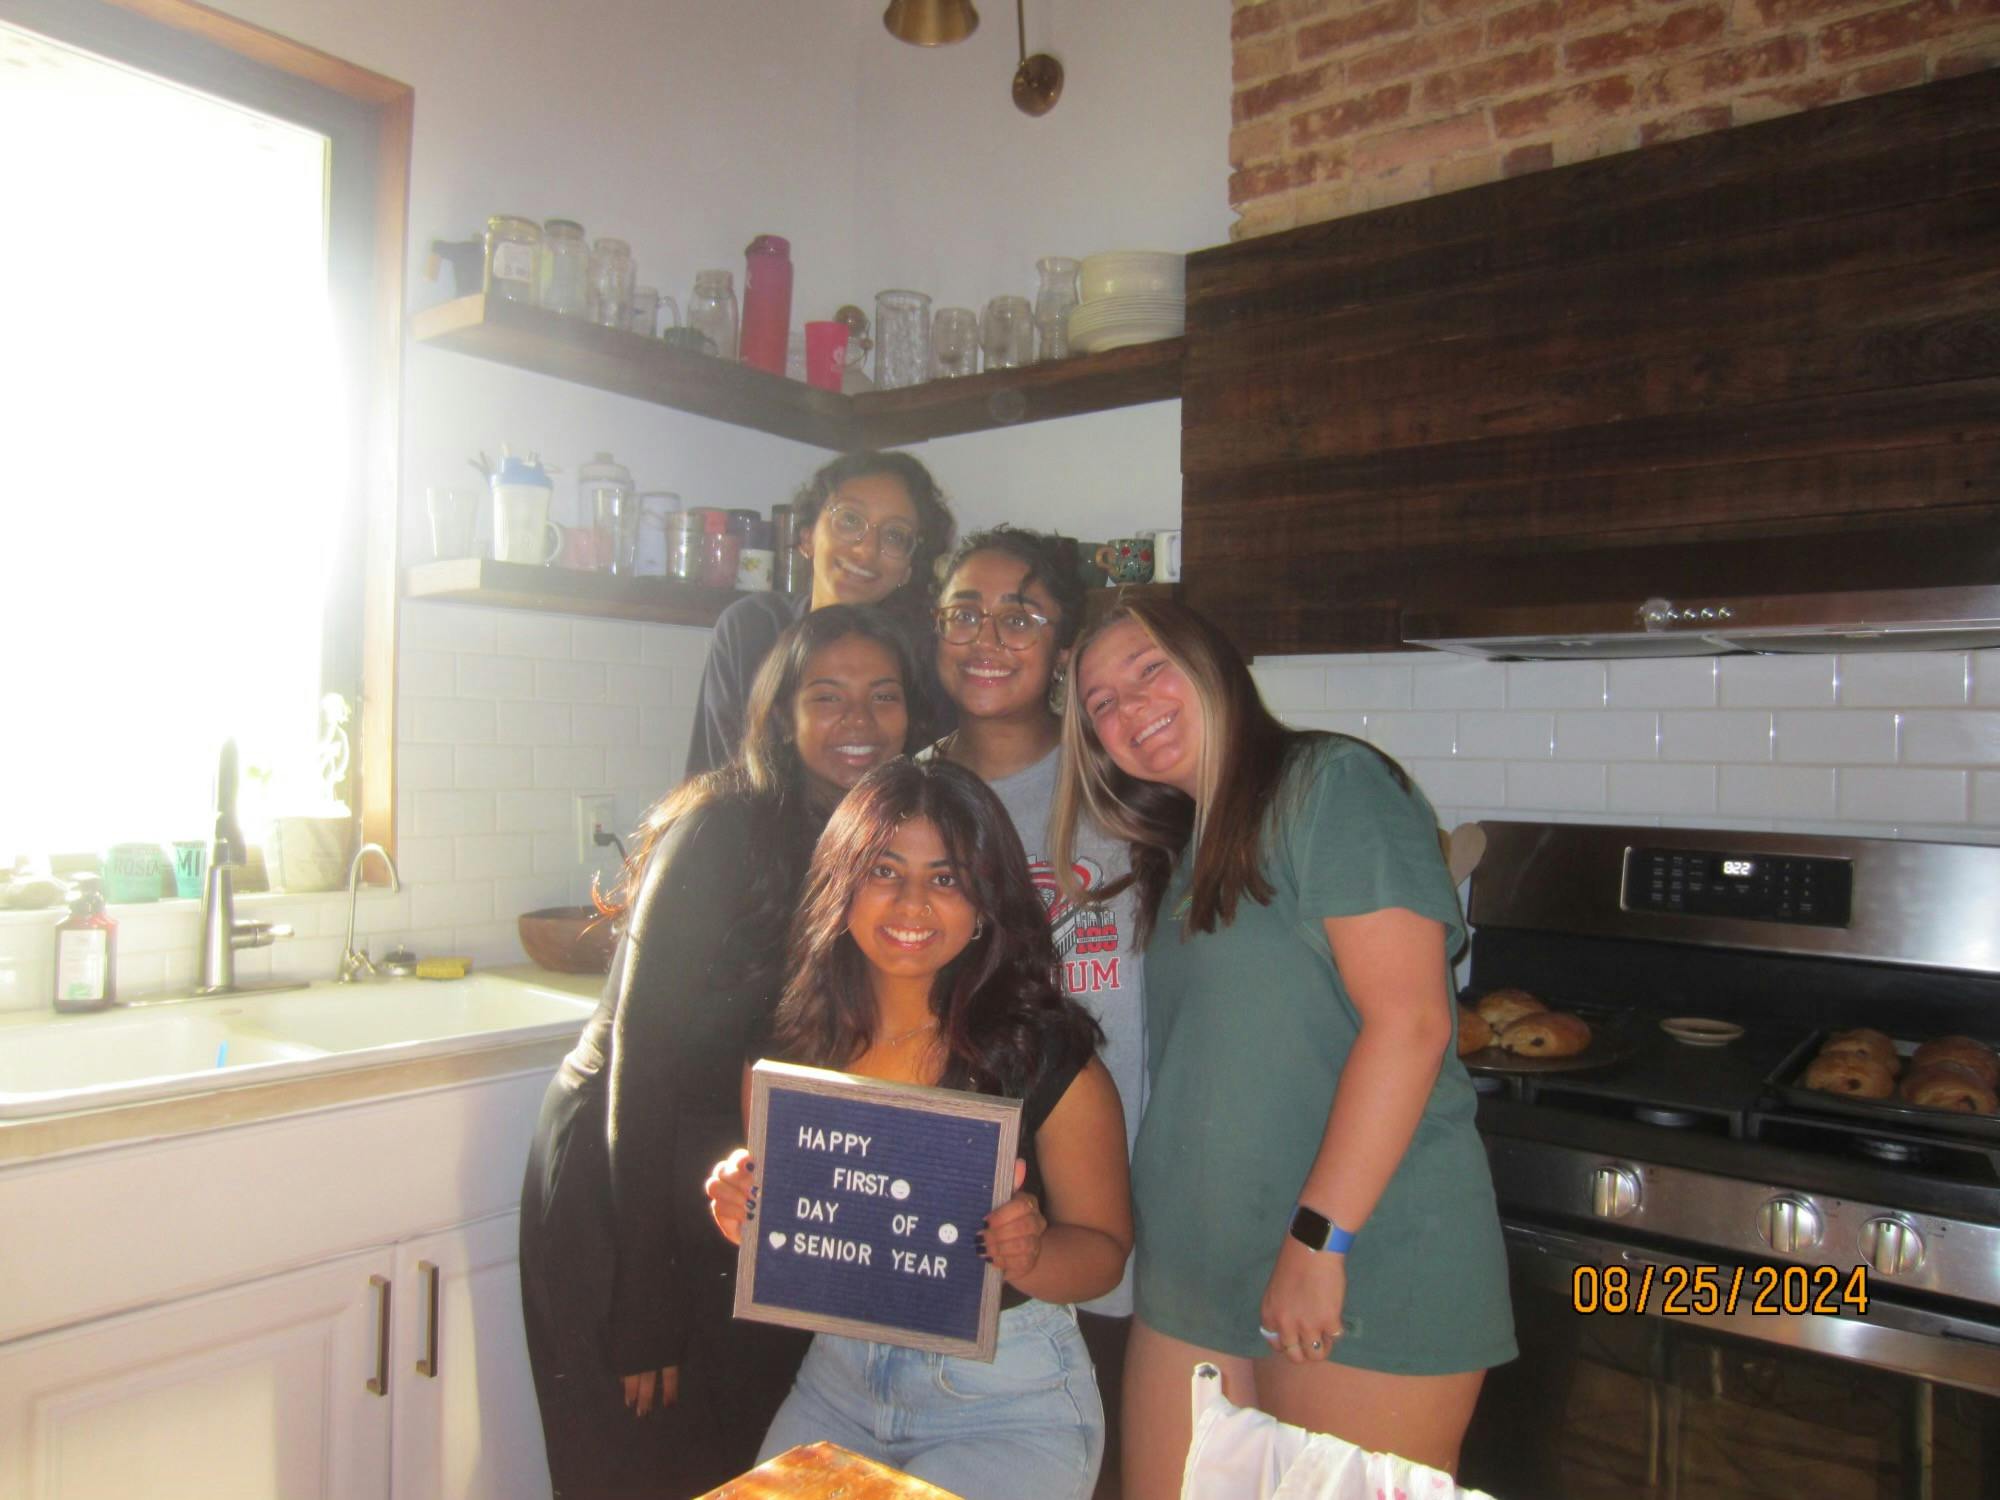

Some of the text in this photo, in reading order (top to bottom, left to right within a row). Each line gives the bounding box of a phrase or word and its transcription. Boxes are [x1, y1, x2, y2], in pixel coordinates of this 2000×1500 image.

[798, 1125, 872, 1157] HAPPY
[833, 1168, 889, 1196] FIRST
[796, 1197, 919, 1237] DAY OF
[793, 1233, 948, 1279] SENIOR YEAR
